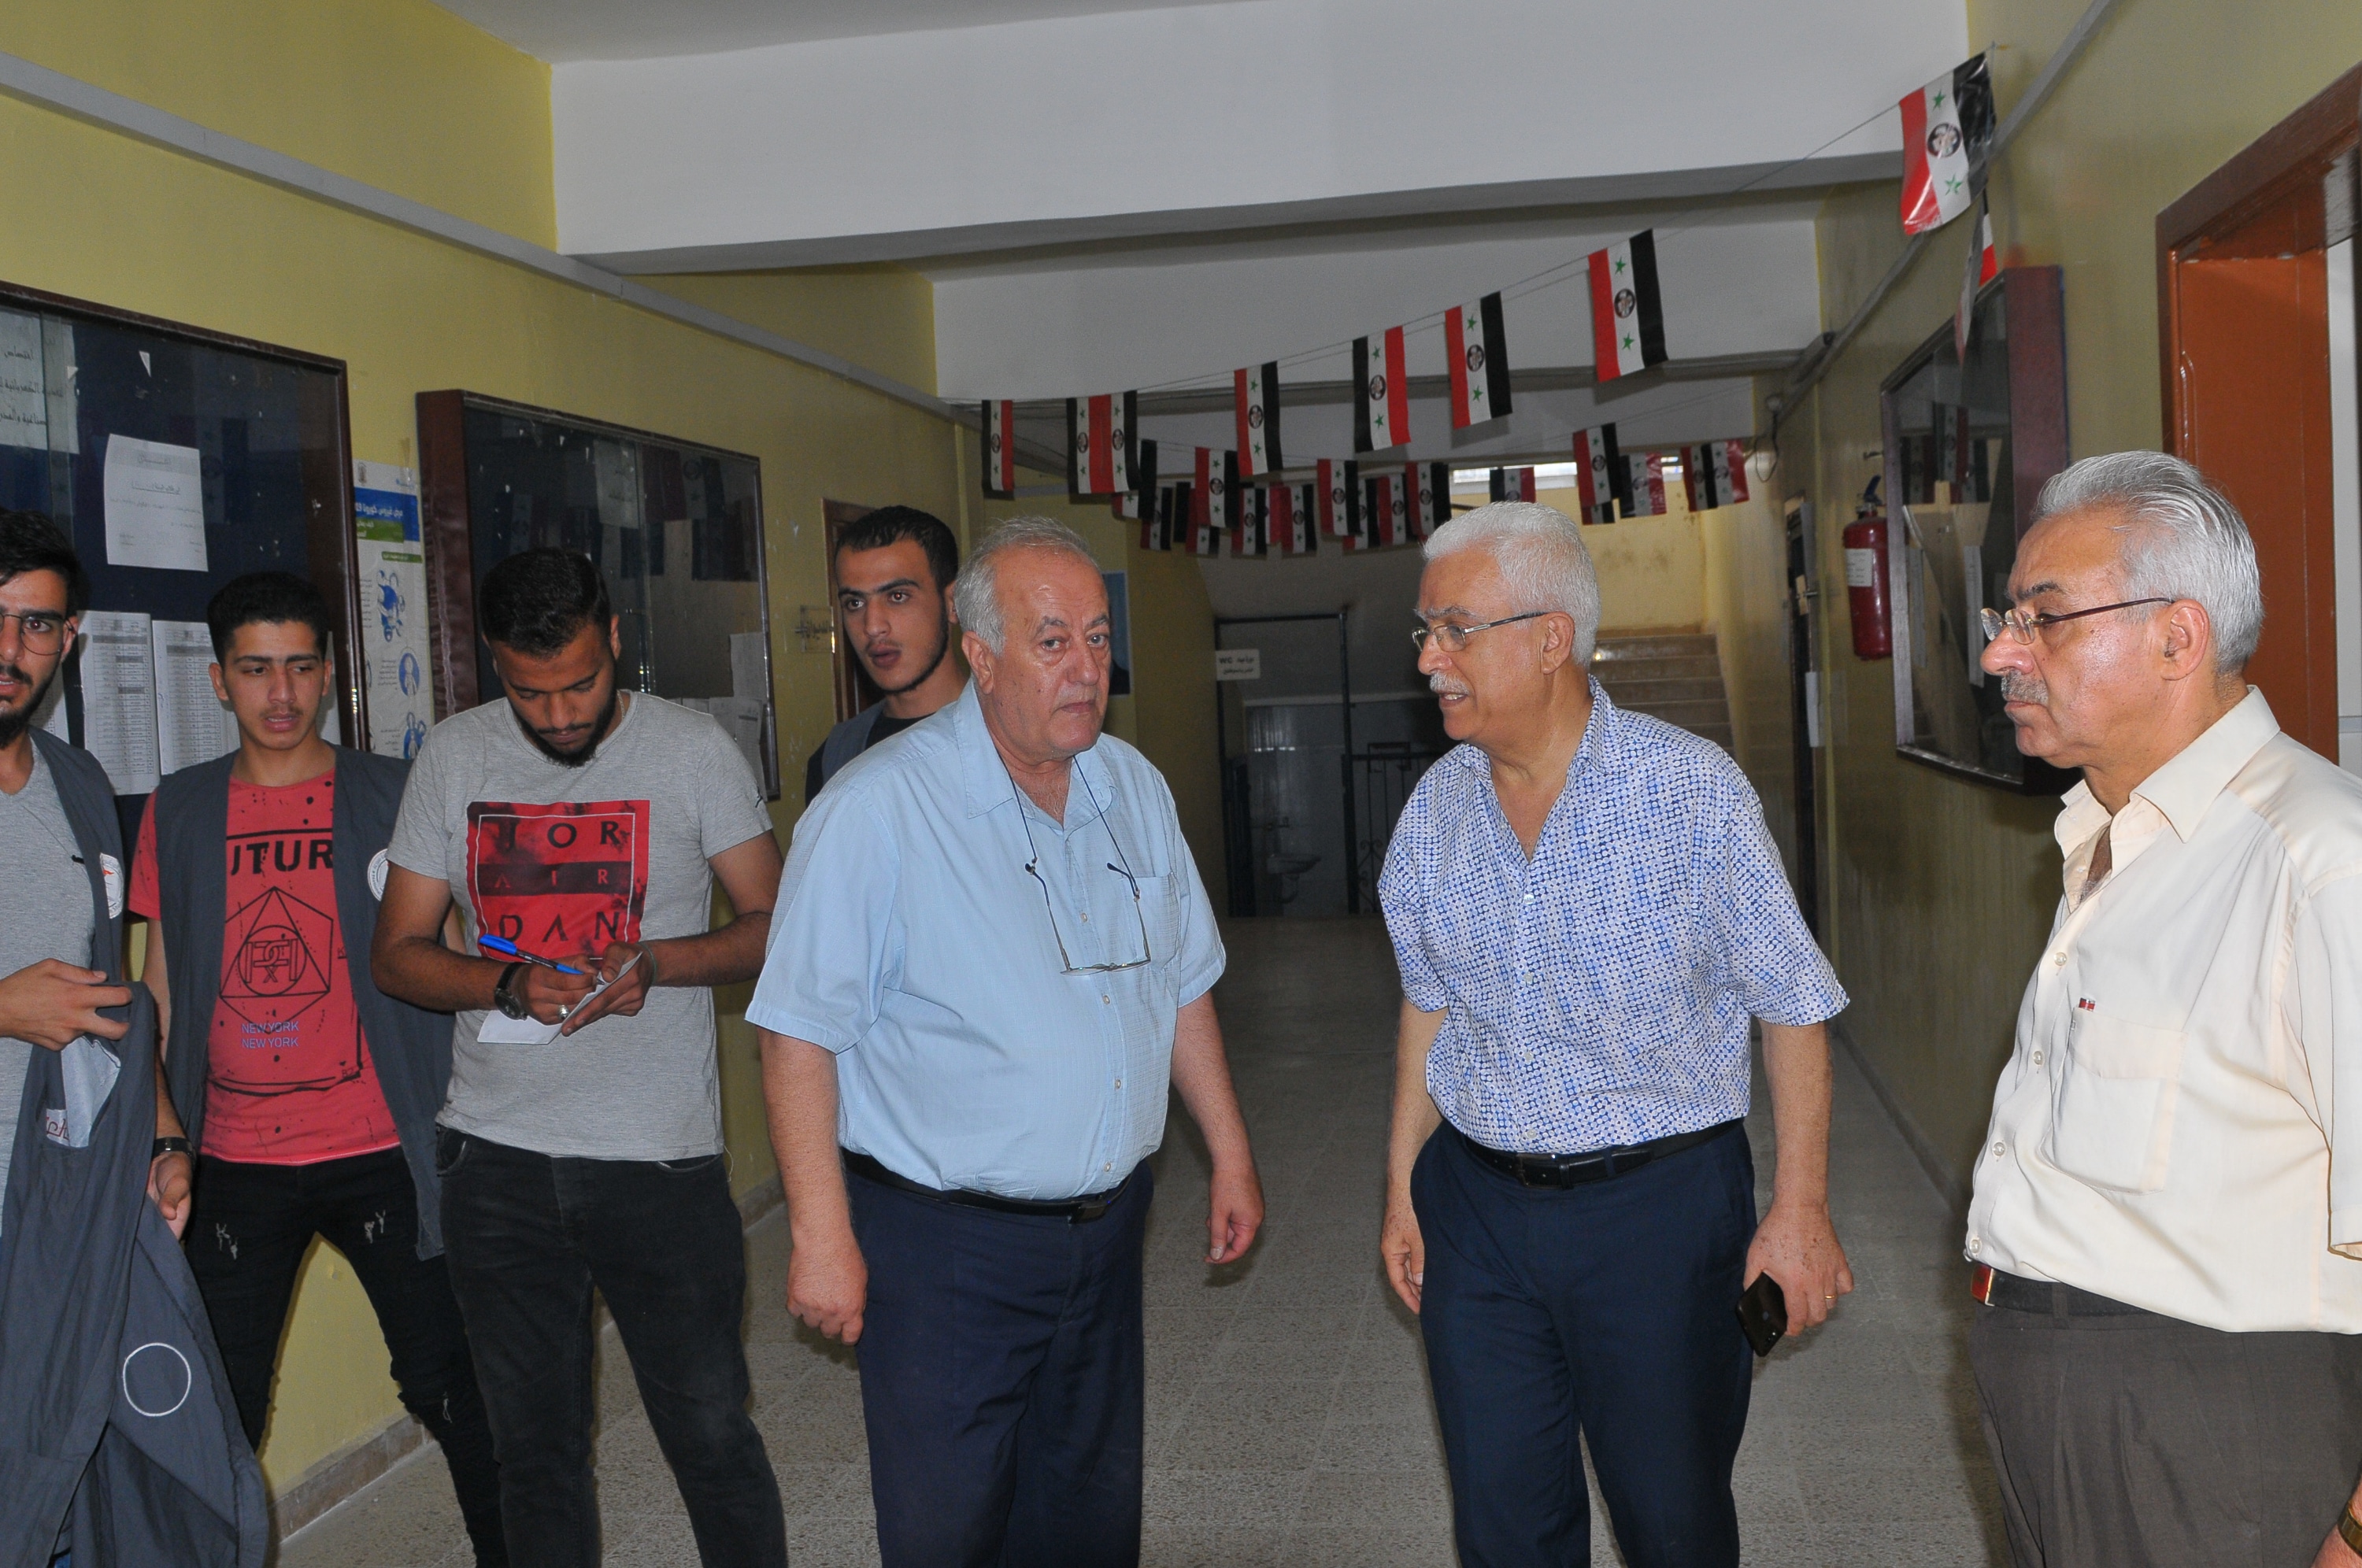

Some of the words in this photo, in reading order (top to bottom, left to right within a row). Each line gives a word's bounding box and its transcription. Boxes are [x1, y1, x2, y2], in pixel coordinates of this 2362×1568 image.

[242, 1023, 265, 1034] NEW
[268, 1021, 299, 1033] YORK
[242, 1037, 265, 1048] NEW
[268, 1037, 299, 1048] YORK
